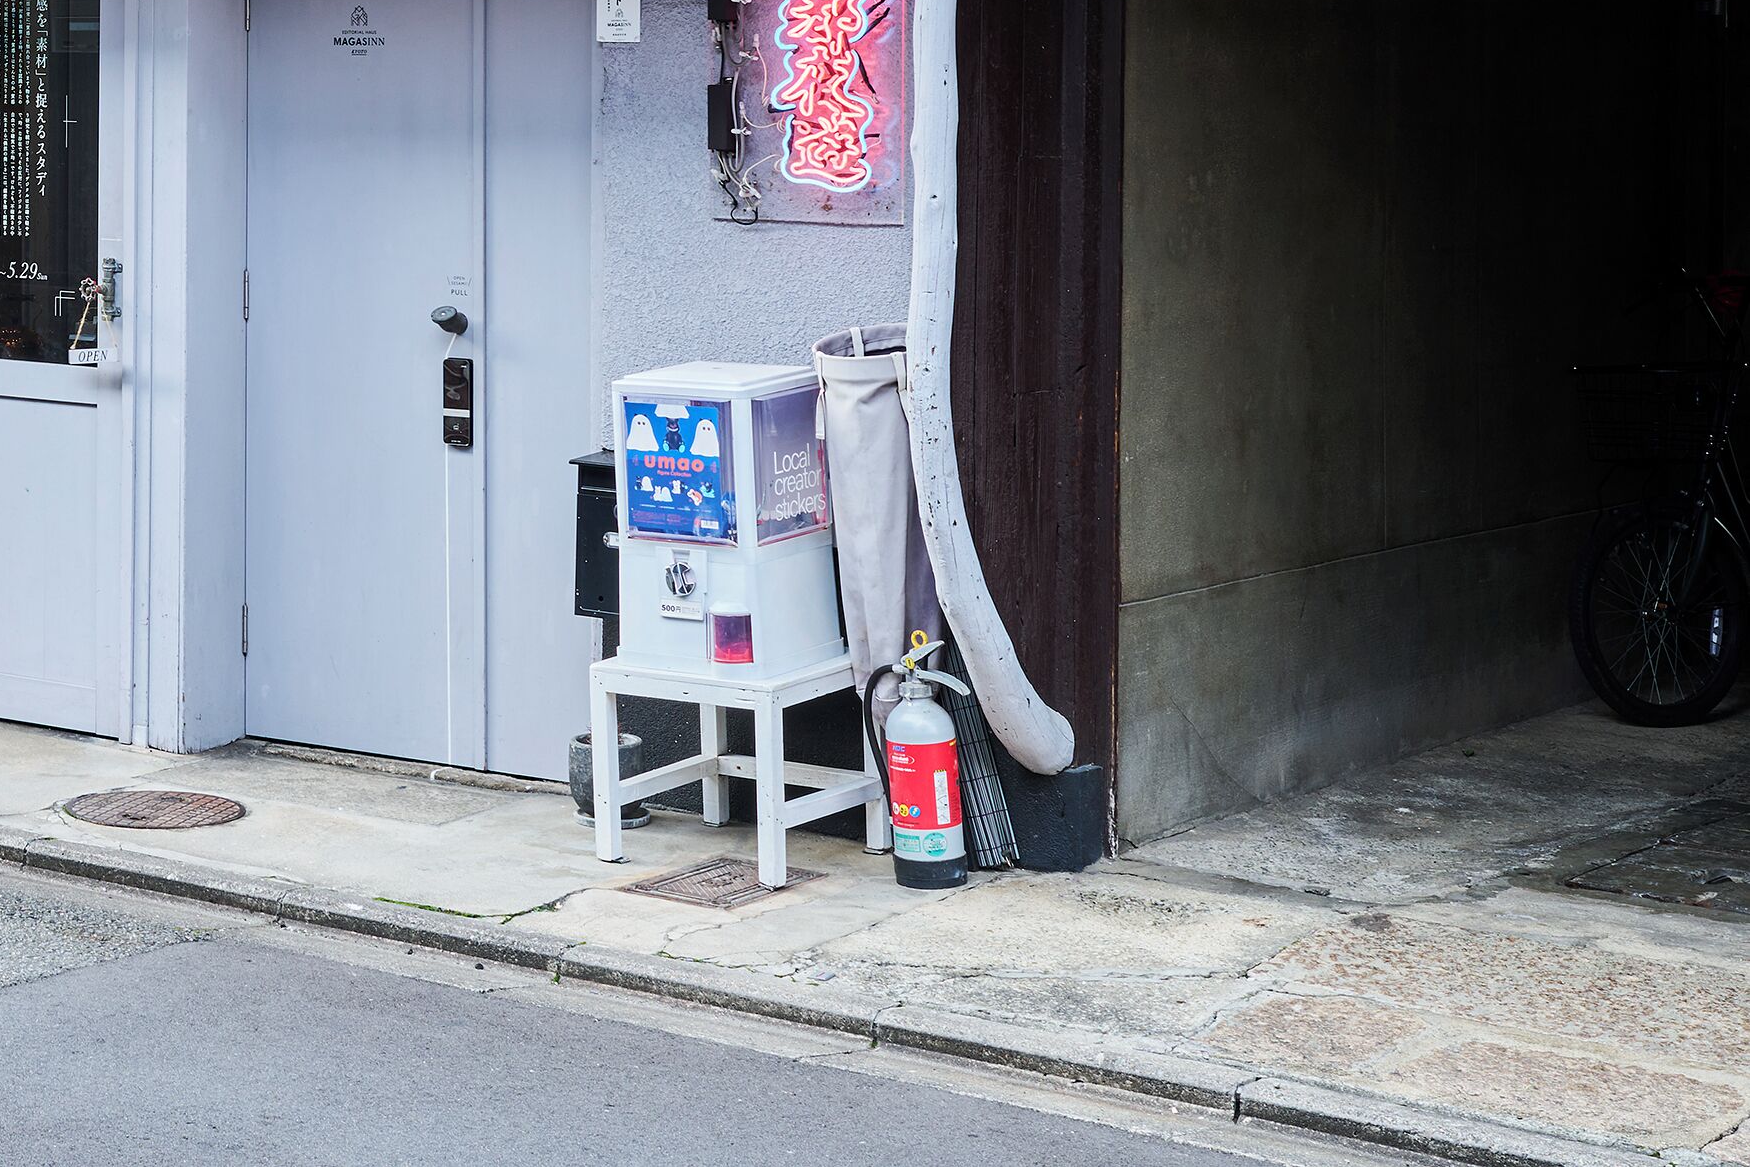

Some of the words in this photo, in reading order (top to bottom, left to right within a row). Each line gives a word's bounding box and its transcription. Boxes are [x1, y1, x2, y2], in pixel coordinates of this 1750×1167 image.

[333, 37, 385, 46] MAGASINN
[78, 350, 109, 363] OPEN
[644, 454, 704, 472] umao
[773, 443, 811, 475] Local
[774, 468, 823, 496] creator
[775, 493, 826, 522] stickers
[661, 604, 681, 613] 500円
